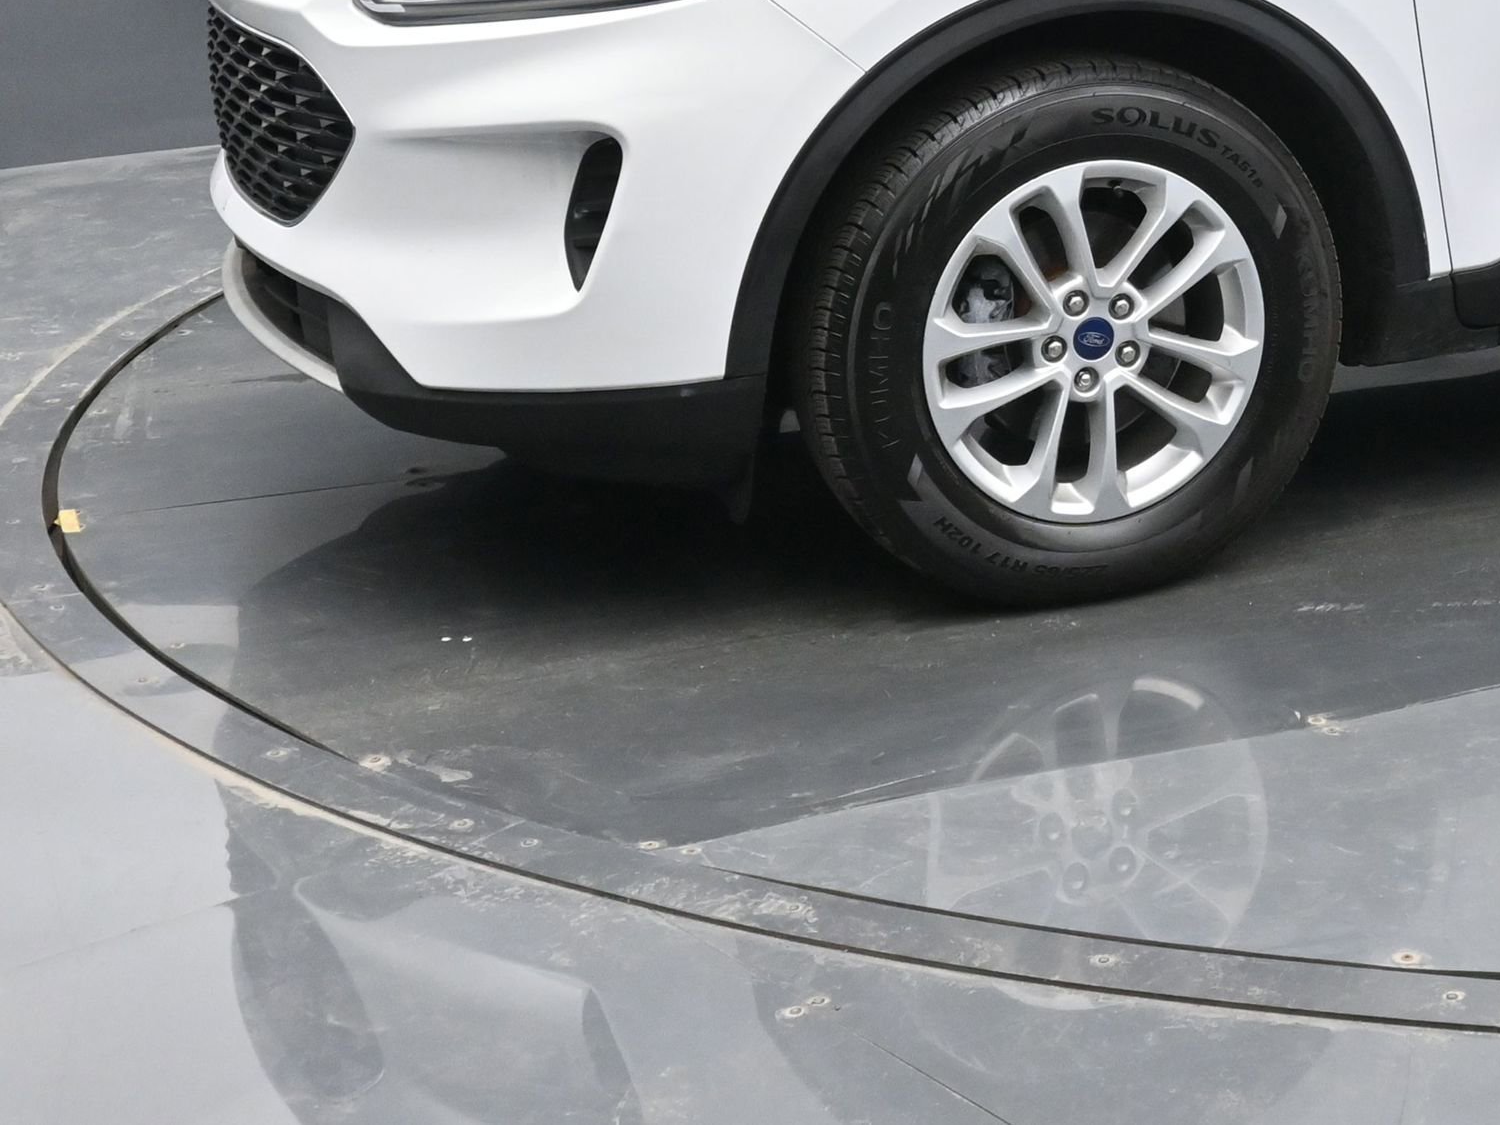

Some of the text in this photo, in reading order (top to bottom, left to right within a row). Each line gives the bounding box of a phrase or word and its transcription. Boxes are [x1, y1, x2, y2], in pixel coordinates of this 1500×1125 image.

[1091, 106, 1221, 149] SOLUS
[933, 516, 982, 555] 102H
[984, 551, 1029, 574] R17
